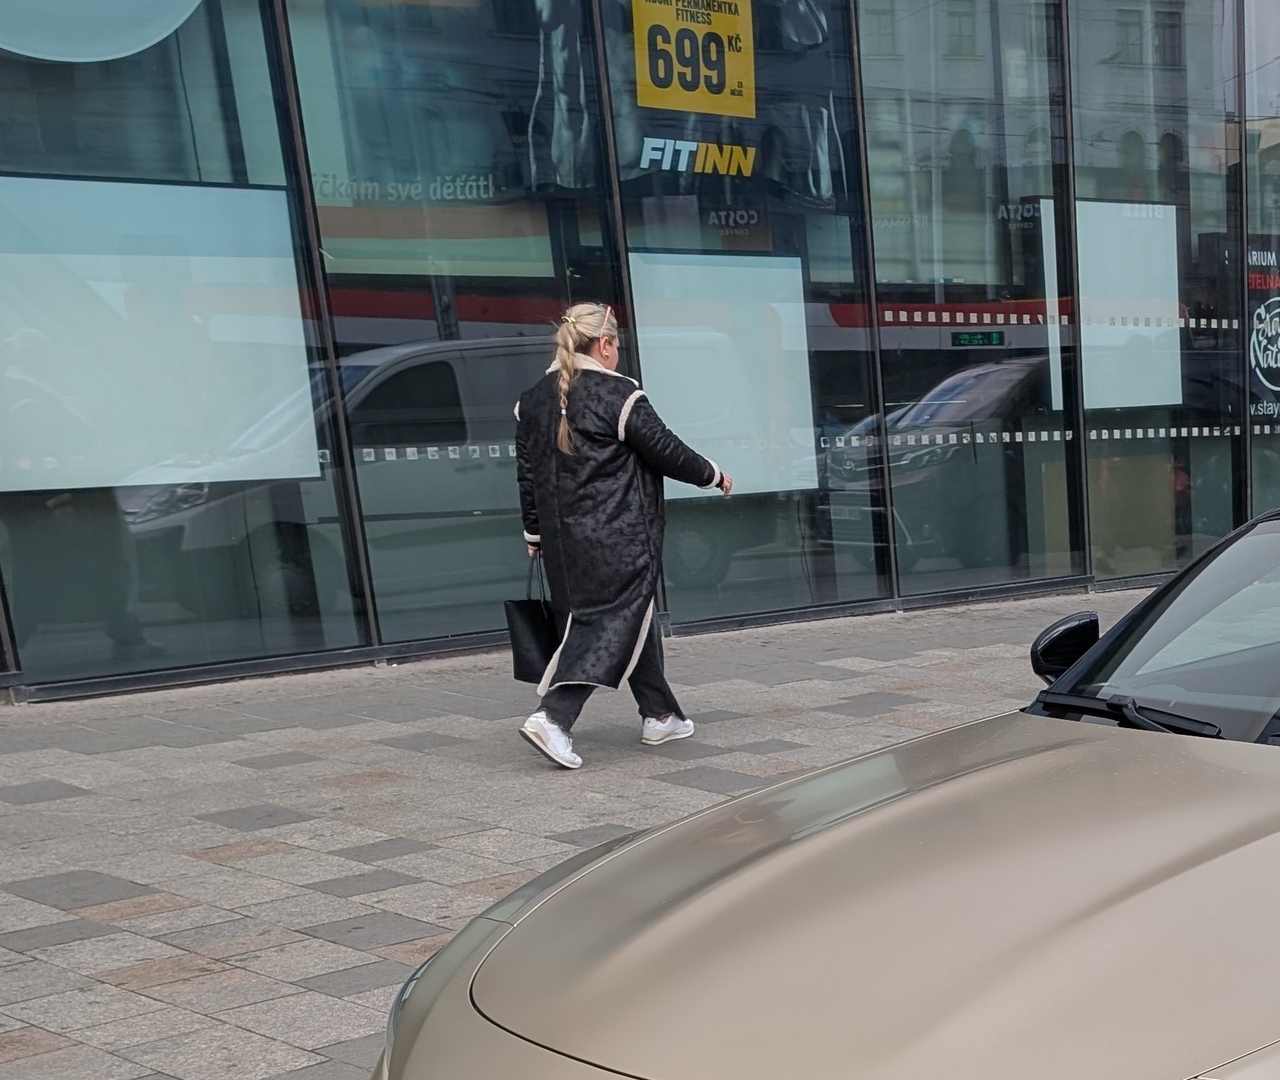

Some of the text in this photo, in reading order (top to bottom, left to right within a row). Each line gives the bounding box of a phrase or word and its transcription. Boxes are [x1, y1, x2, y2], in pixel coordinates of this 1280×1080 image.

[675, 8, 712, 25] FITNESS
[647, 24, 742, 95] 699 KČ
[639, 137, 756, 177] FITINN
[387, 176, 422, 200] své
